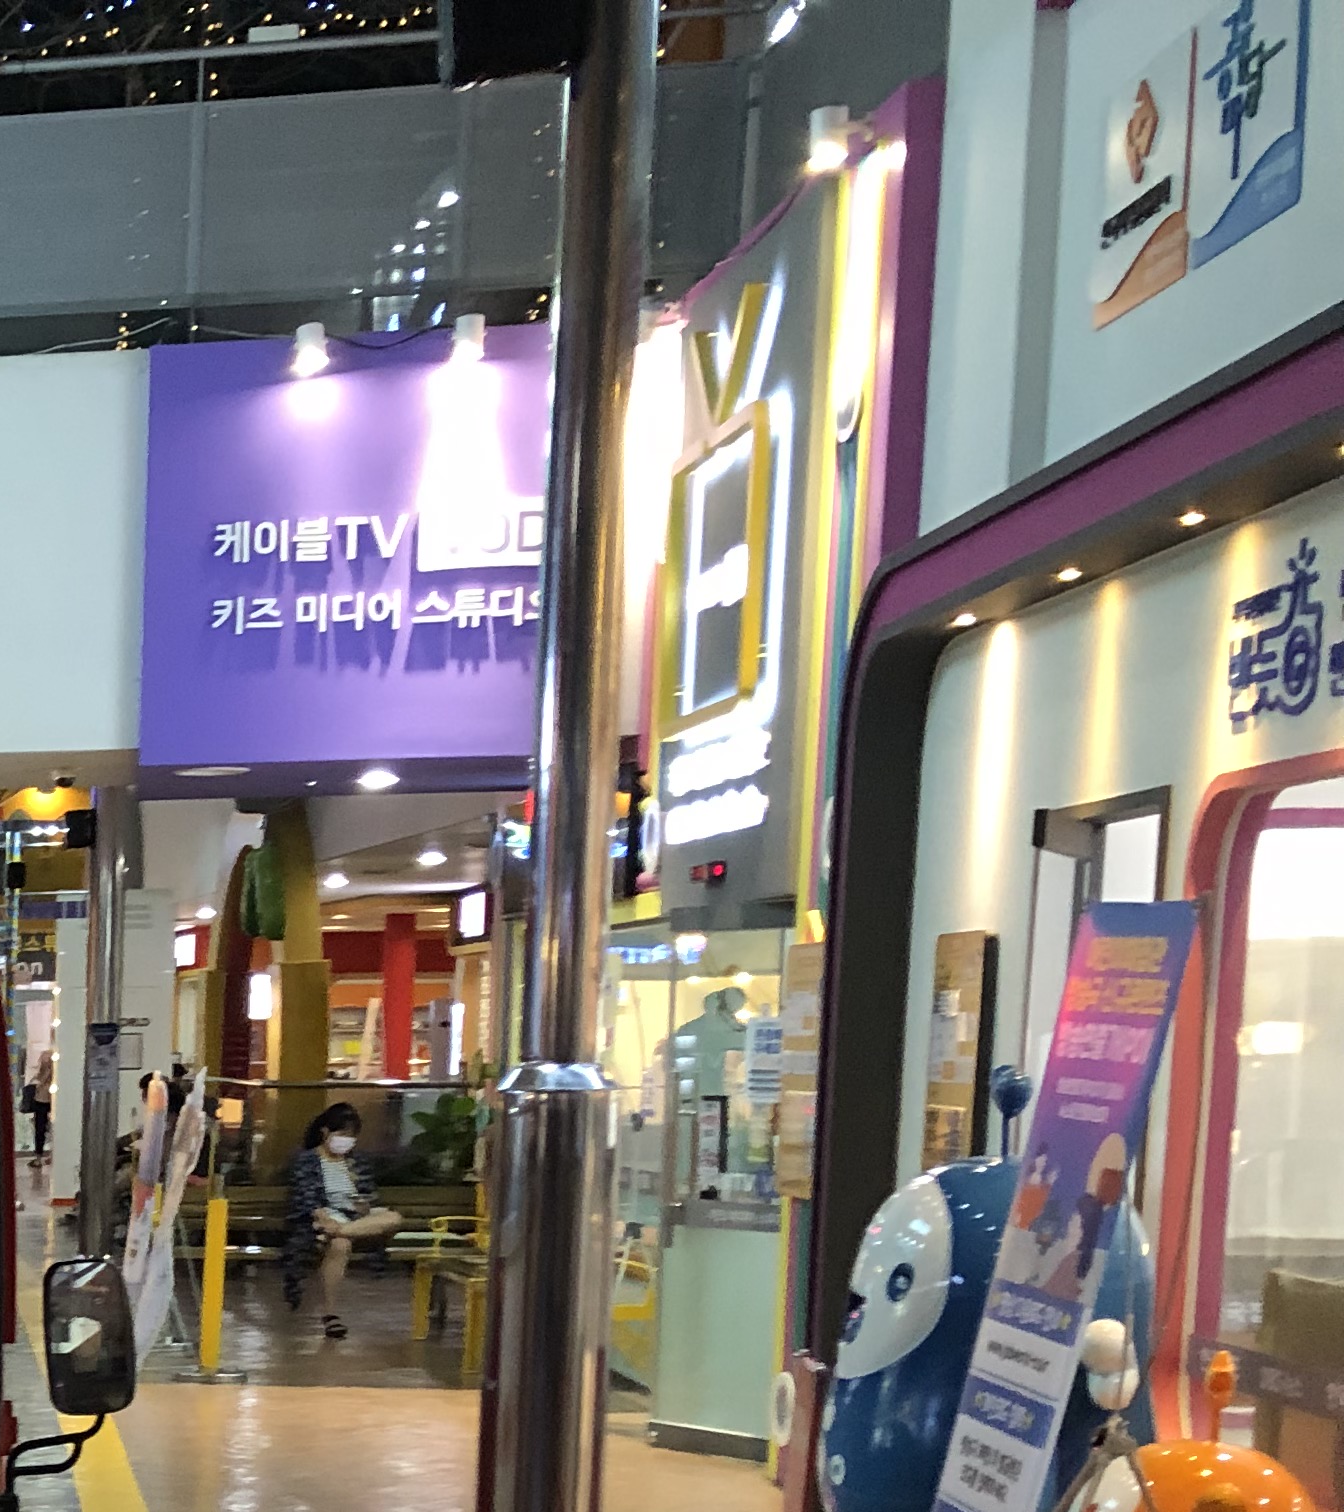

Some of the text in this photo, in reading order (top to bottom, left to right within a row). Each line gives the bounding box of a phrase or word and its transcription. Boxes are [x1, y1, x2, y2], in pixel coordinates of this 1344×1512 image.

[214, 514, 409, 563] 케이블TV
[212, 596, 284, 635] 키즈
[296, 588, 403, 633] 미디어
